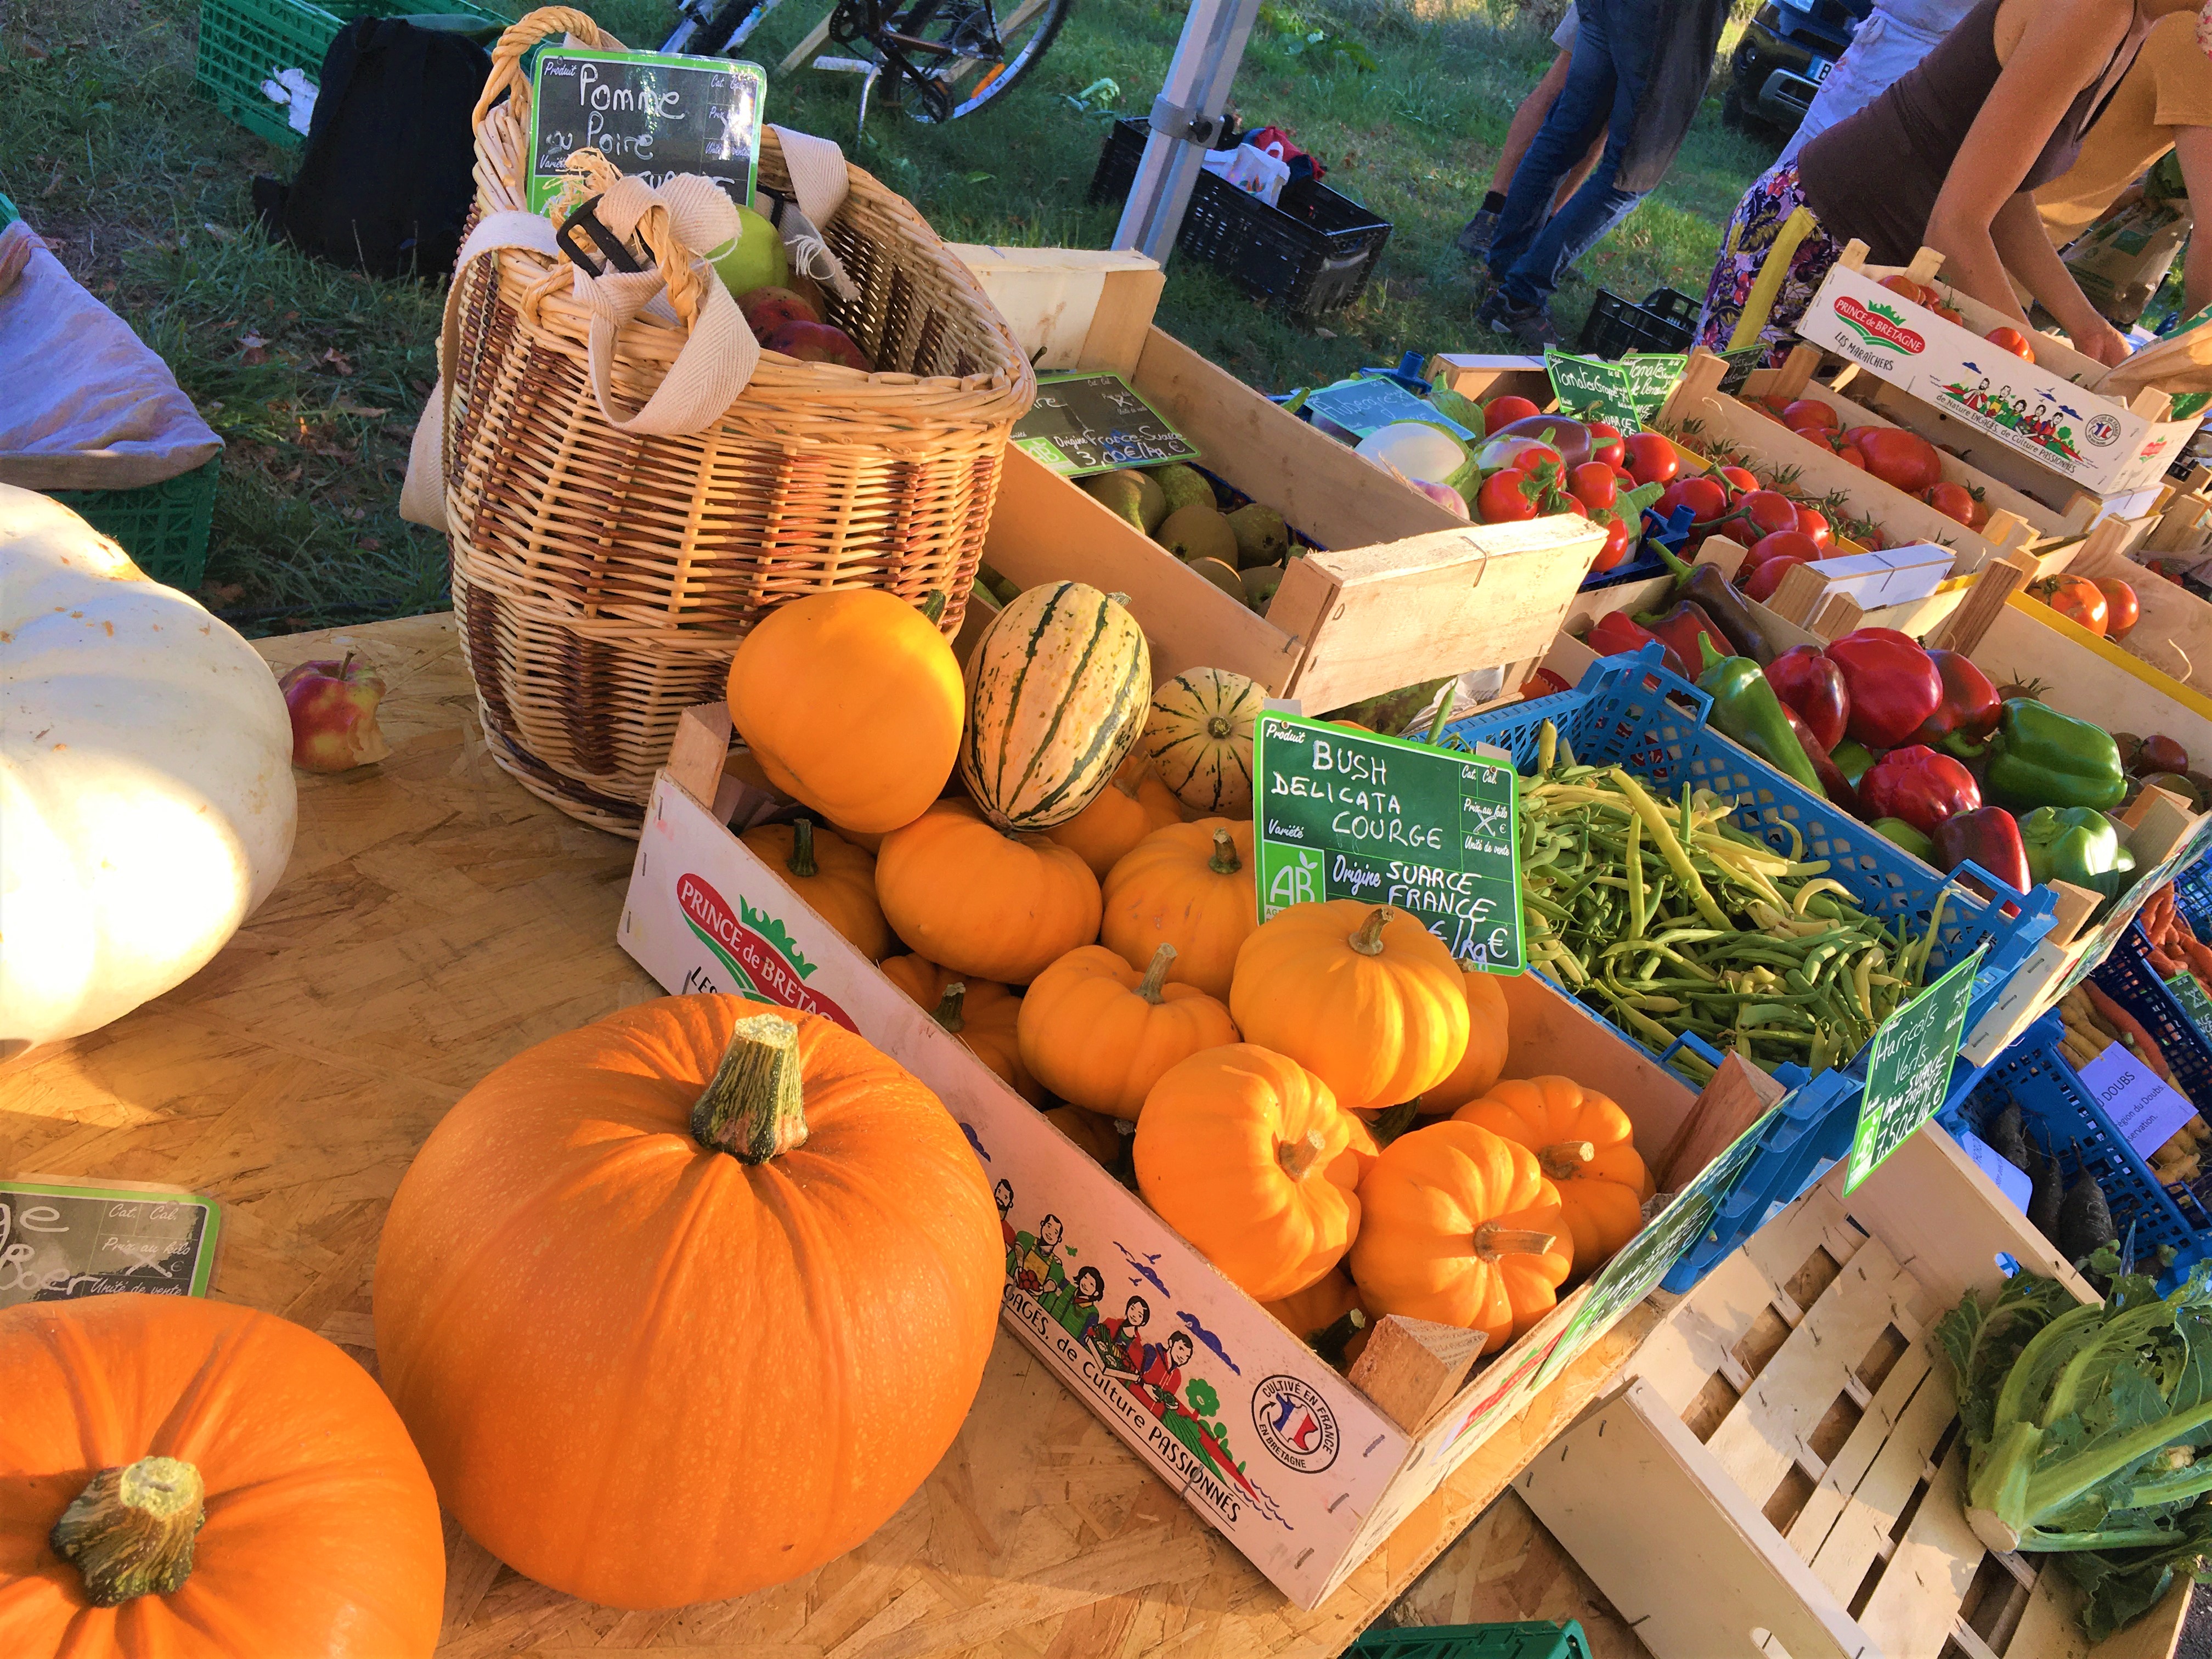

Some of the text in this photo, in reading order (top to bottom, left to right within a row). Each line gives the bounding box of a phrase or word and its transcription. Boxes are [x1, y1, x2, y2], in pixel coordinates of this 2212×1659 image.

[544, 62, 578, 76] Produit
[580, 64, 685, 120] Pomme
[587, 111, 653, 160] Poire
[1836, 299, 1922, 352] PRINCE de BRETAGNE
[1835, 331, 1894, 371] LES MARAÎCHERS
[1551, 360, 1595, 391] Tomates
[1054, 436, 1088, 452] Origine
[1169, 441, 1186, 454] €
[1936, 394, 1945, 403] de
[1947, 399, 1971, 416] Nature
[2001, 428, 2011, 438] de
[2012, 434, 2039, 453] Culture
[2039, 449, 2077, 473] PASSIONNÉS
[1266, 724, 1305, 744] Produit
[1312, 740, 1386, 786] BUSH
[1462, 765, 1497, 785] Cat. Cal.
[1271, 771, 1401, 814] DELICATA
[1464, 797, 1508, 819] Prix au kilo
[1268, 817, 1305, 839] Variété
[1332, 811, 1443, 849] COURGE
[1465, 835, 1510, 856] Unité de vente
[1499, 823, 1506, 834] €
[1269, 865, 1316, 905] AB
[1332, 854, 1482, 896] Origine SUARCE
[1387, 884, 1497, 923] FRANCE
[681, 879, 837, 1022] PRINCE de BRETA
[1487, 927, 1509, 959] €
[1875, 992, 1939, 1070] Haricots
[1893, 1030, 1929, 1085] Verts
[1905, 1045, 1950, 1094] SUARCE
[2102, 1071, 2136, 1102] DOUBS
[2134, 1103, 2144, 1114] du
[2142, 1085, 2166, 1107] Doubs.
[109, 1203, 177, 1221] Cat. Cal.
[101, 1237, 190, 1256] Prix au kilo
[170, 1261, 184, 1272] €
[91, 1278, 182, 1296] Unité de vente
[1003, 1283, 1241, 1522] GAGÉS. de Culture PASSIONNÉS
[1262, 1380, 1335, 1455] CULTIVÉ EN FRANCE
[1259, 1424, 1307, 1469] EN BRETAGNE
